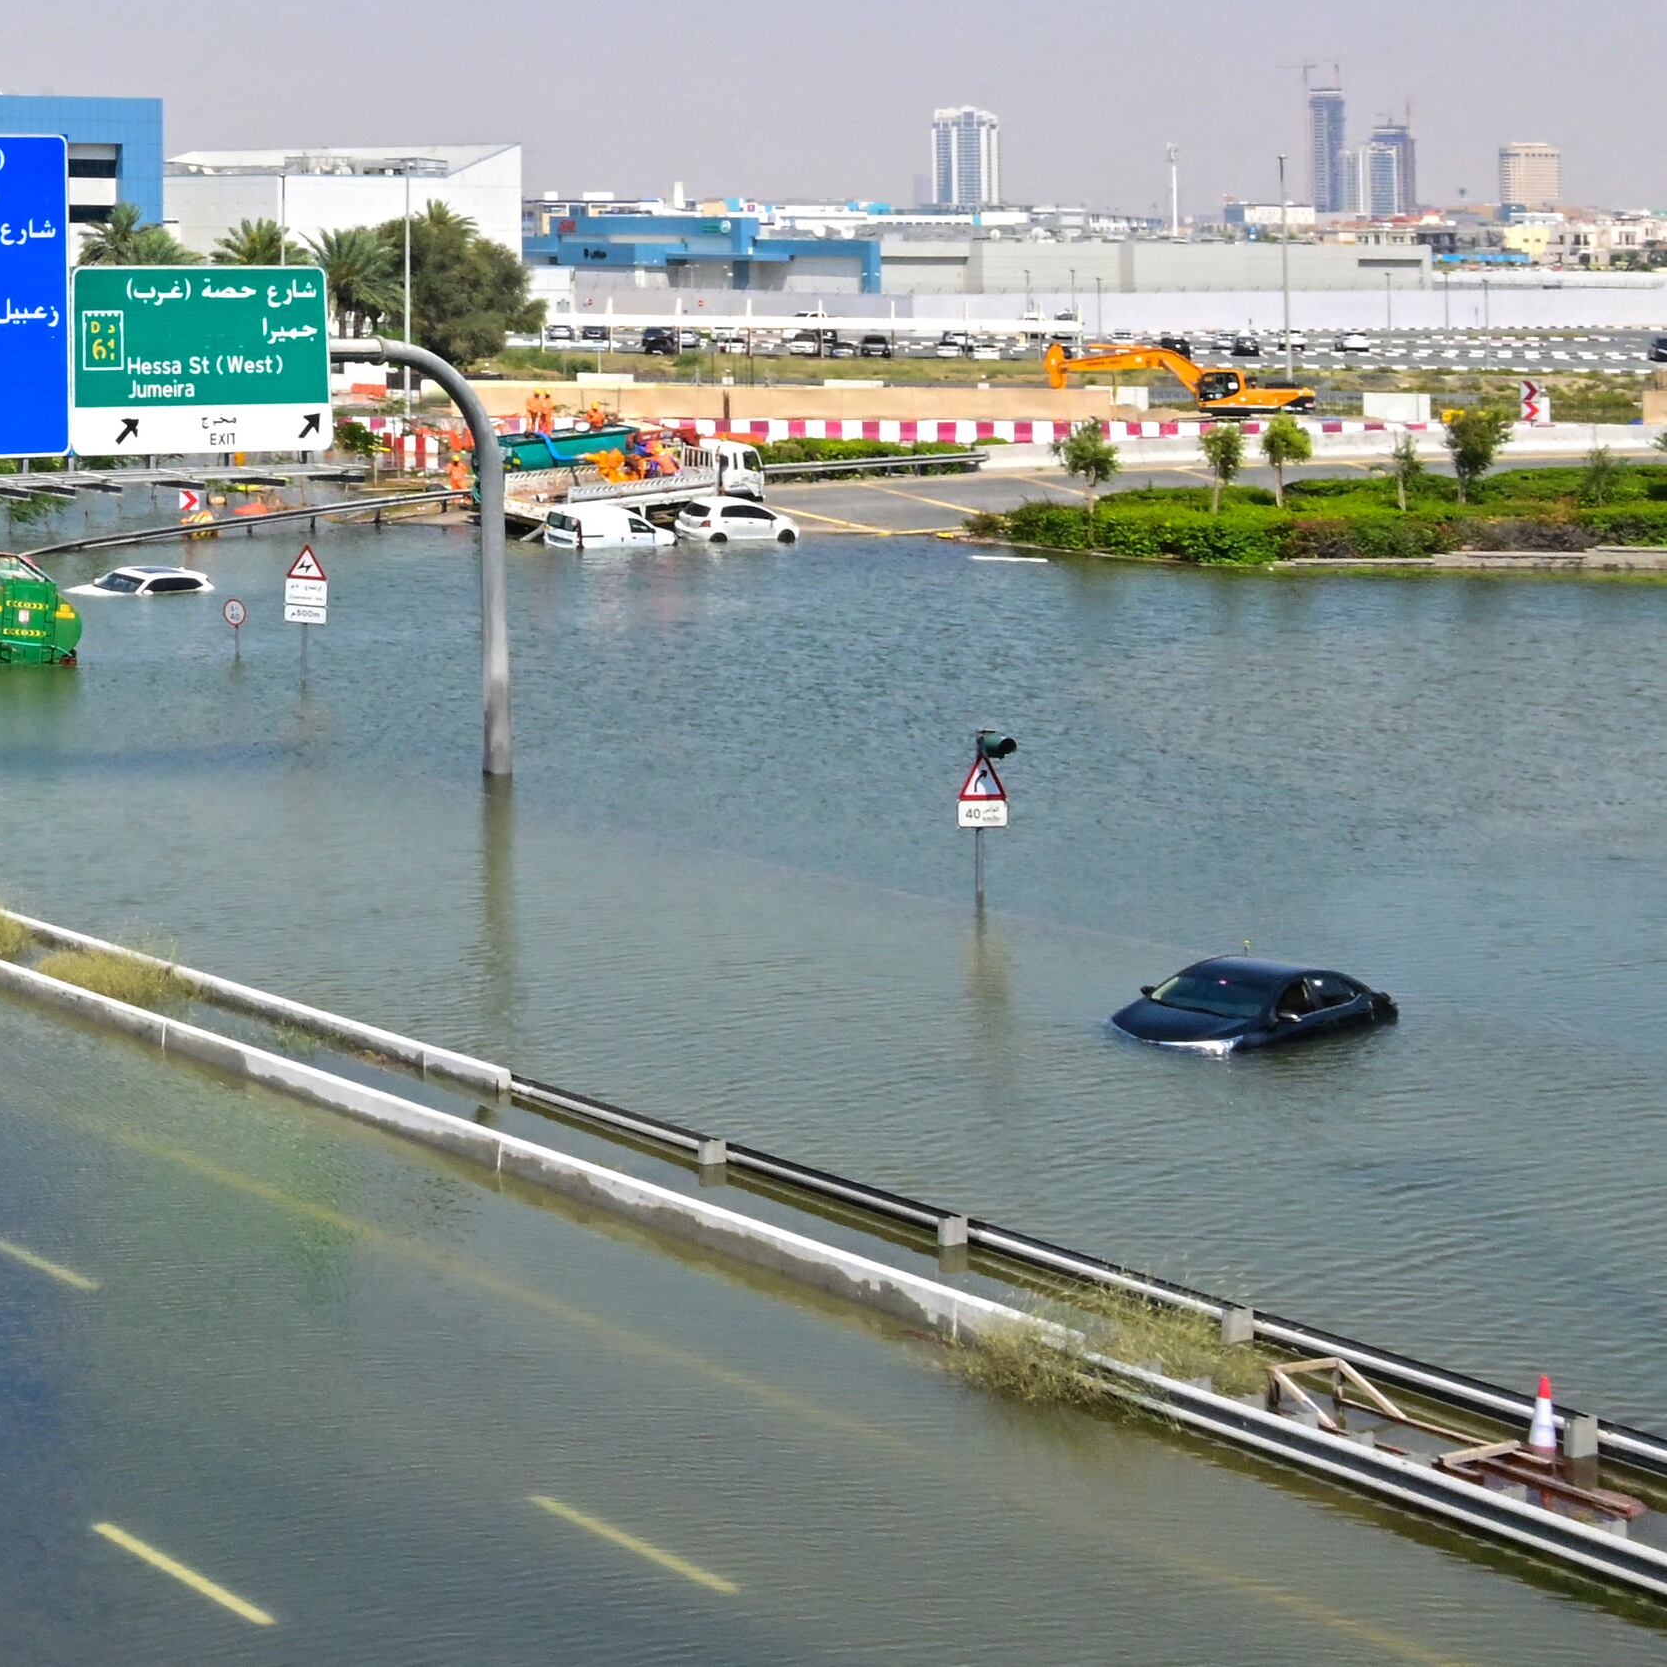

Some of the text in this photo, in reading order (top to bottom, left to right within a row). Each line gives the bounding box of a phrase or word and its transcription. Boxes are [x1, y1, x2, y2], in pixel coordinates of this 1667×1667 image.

[0, 218, 57, 246] شارع
[126, 277, 317, 308] شارع حصة (غرب)
[90, 320, 101, 334] D
[262, 316, 317, 344] جميرا
[127, 354, 284, 375] Hessa St (West)
[128, 379, 195, 399] Jumeira
[201, 414, 237, 429] مخرج
[210, 432, 236, 445] EXIT
[965, 808, 981, 819] 40
